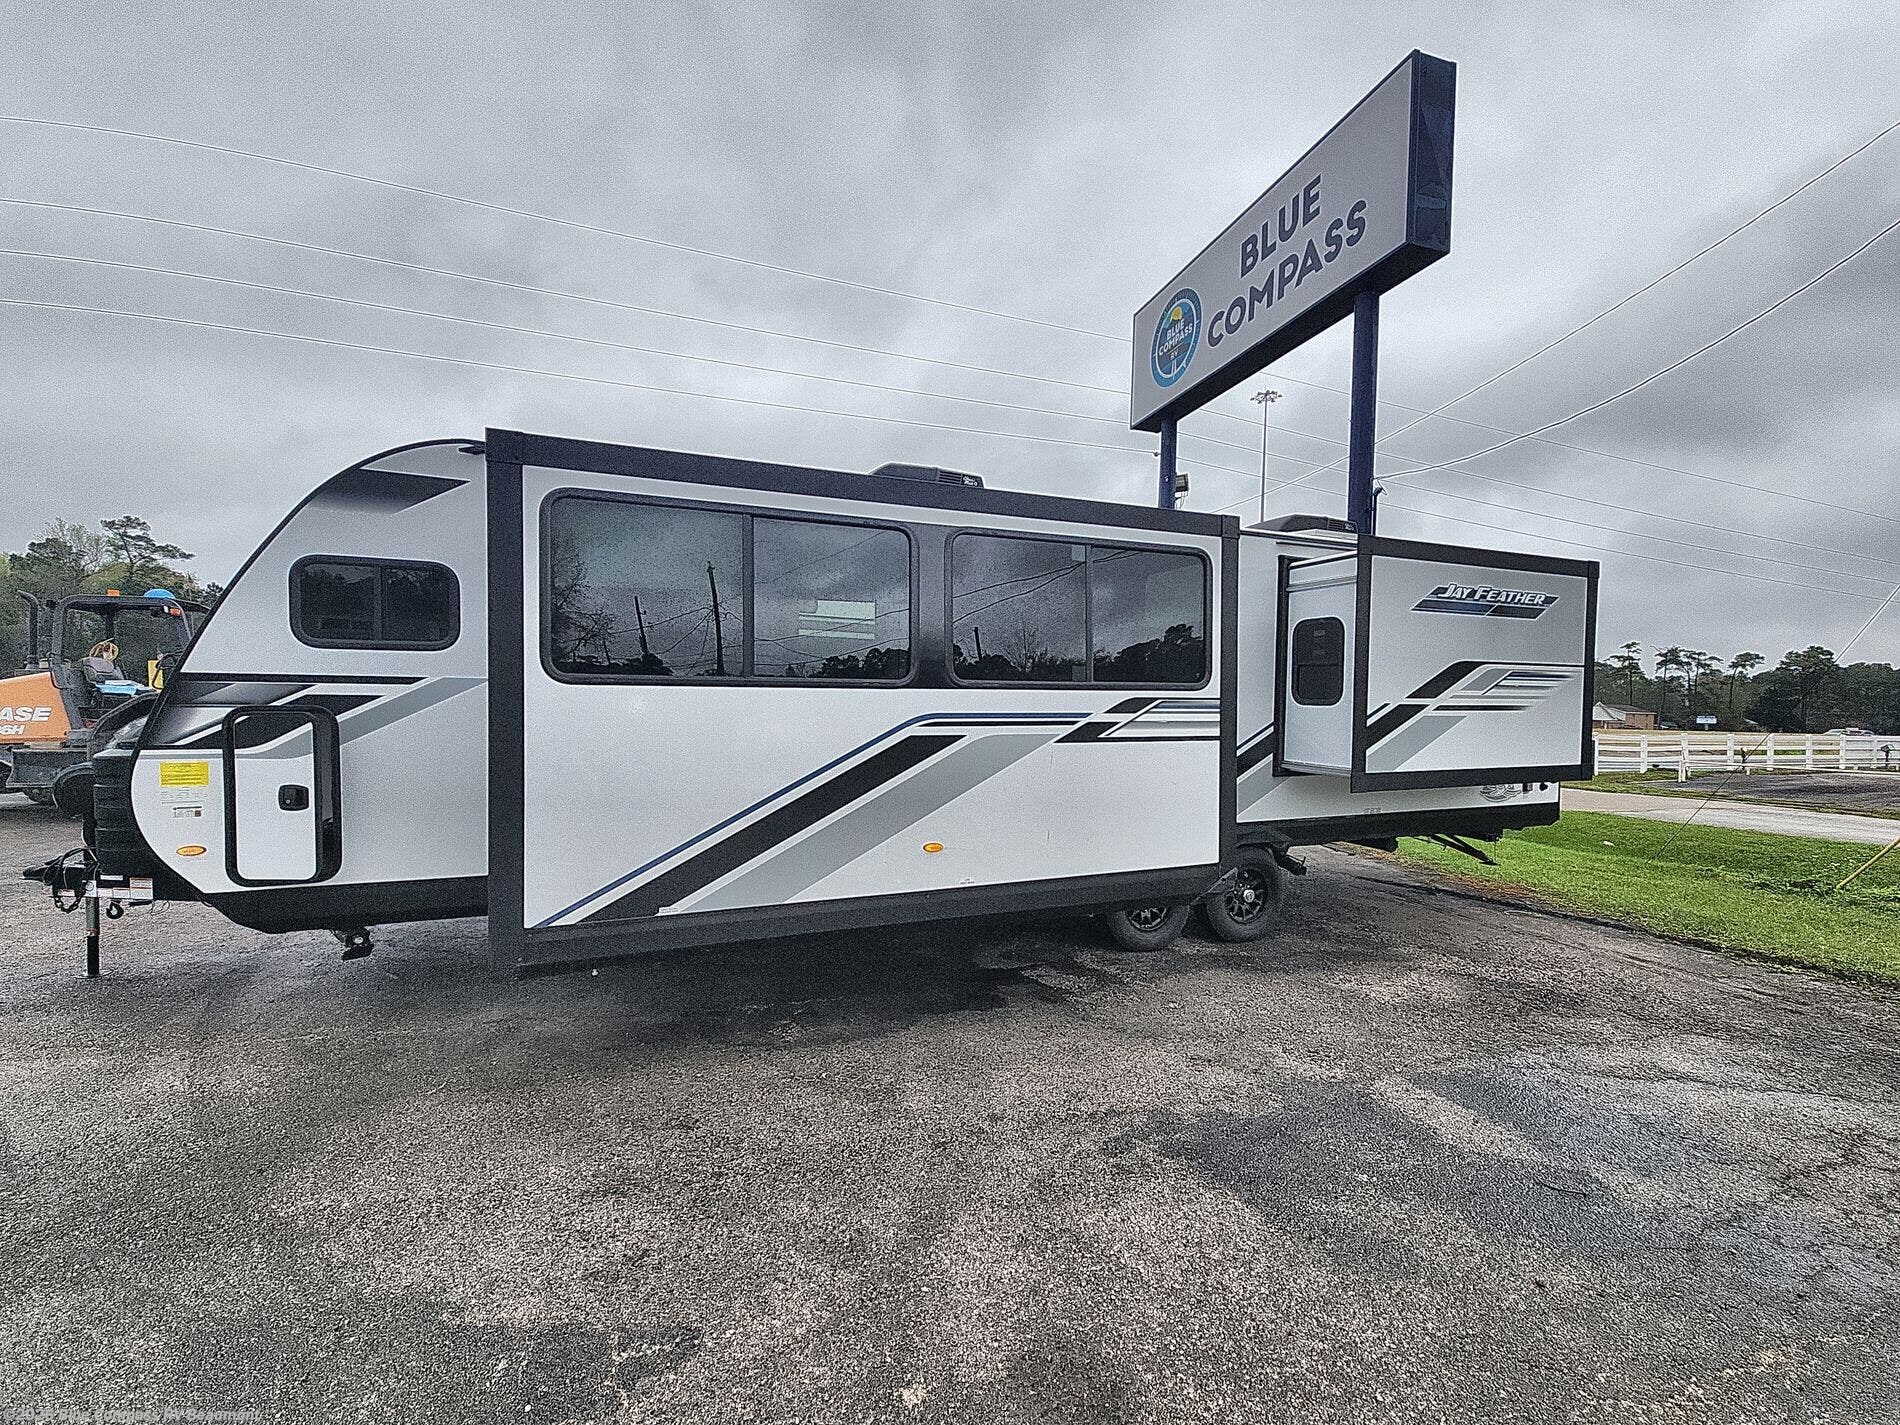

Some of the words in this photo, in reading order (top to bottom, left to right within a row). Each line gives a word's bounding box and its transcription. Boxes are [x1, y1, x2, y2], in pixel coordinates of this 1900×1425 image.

[1240, 174, 1322, 278] BLUE
[1207, 200, 1367, 348] COMPASS
[1159, 323, 1193, 356] COMPASS
[1166, 318, 1185, 341] BLUE
[1170, 349, 1178, 360] RV
[1437, 584, 1473, 599] JAY
[1473, 586, 1547, 605] FEATHER
[0, 706, 52, 722] ASE
